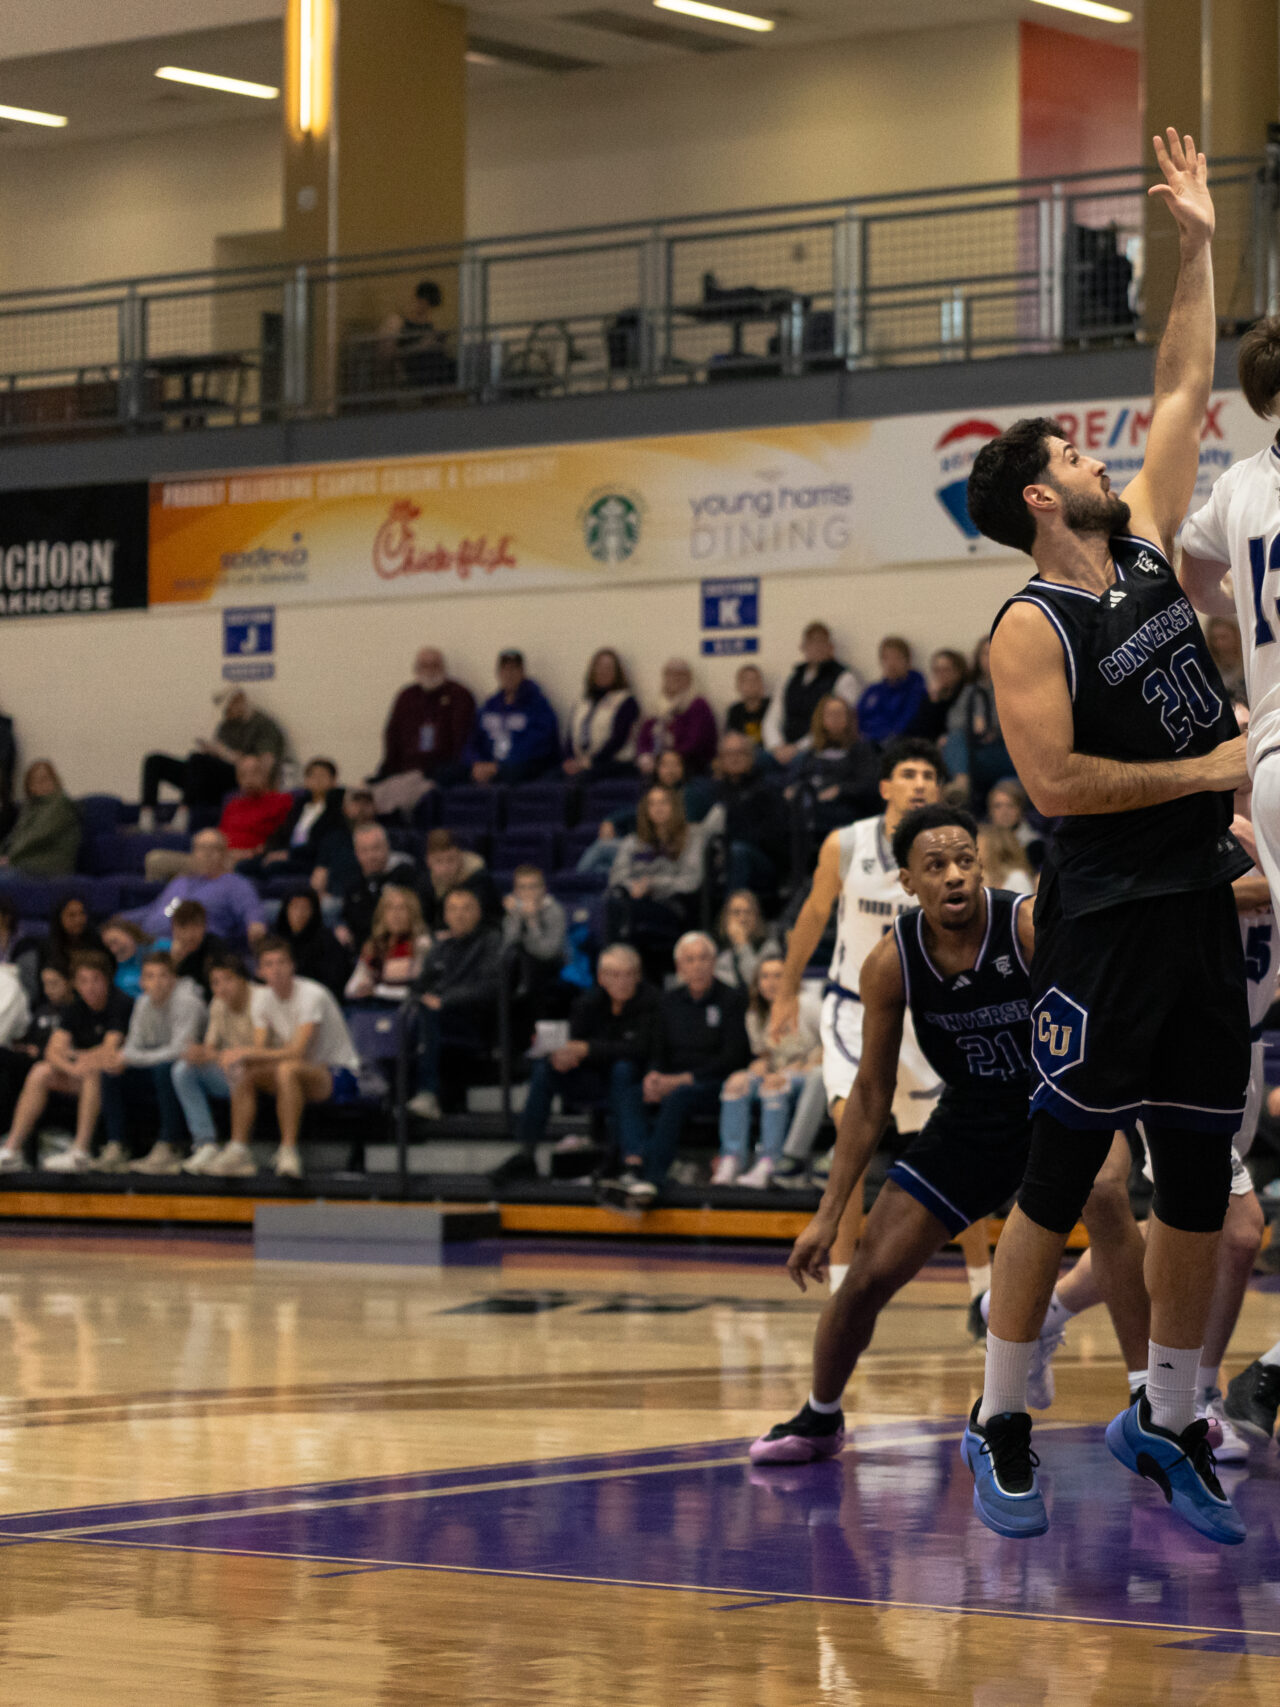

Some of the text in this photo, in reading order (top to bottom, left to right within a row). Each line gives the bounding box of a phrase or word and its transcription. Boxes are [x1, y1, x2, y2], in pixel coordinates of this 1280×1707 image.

[1055, 402, 1225, 448] RE/MX
[690, 514, 850, 560] DINING
[0, 539, 115, 591] GHORN
[718, 598, 741, 626] K
[240, 625, 259, 653] J
[1099, 597, 1195, 686] CONVERSE
[1142, 642, 1223, 753] 20
[956, 1030, 1031, 1081] 21
[1037, 1010, 1073, 1057] CU
